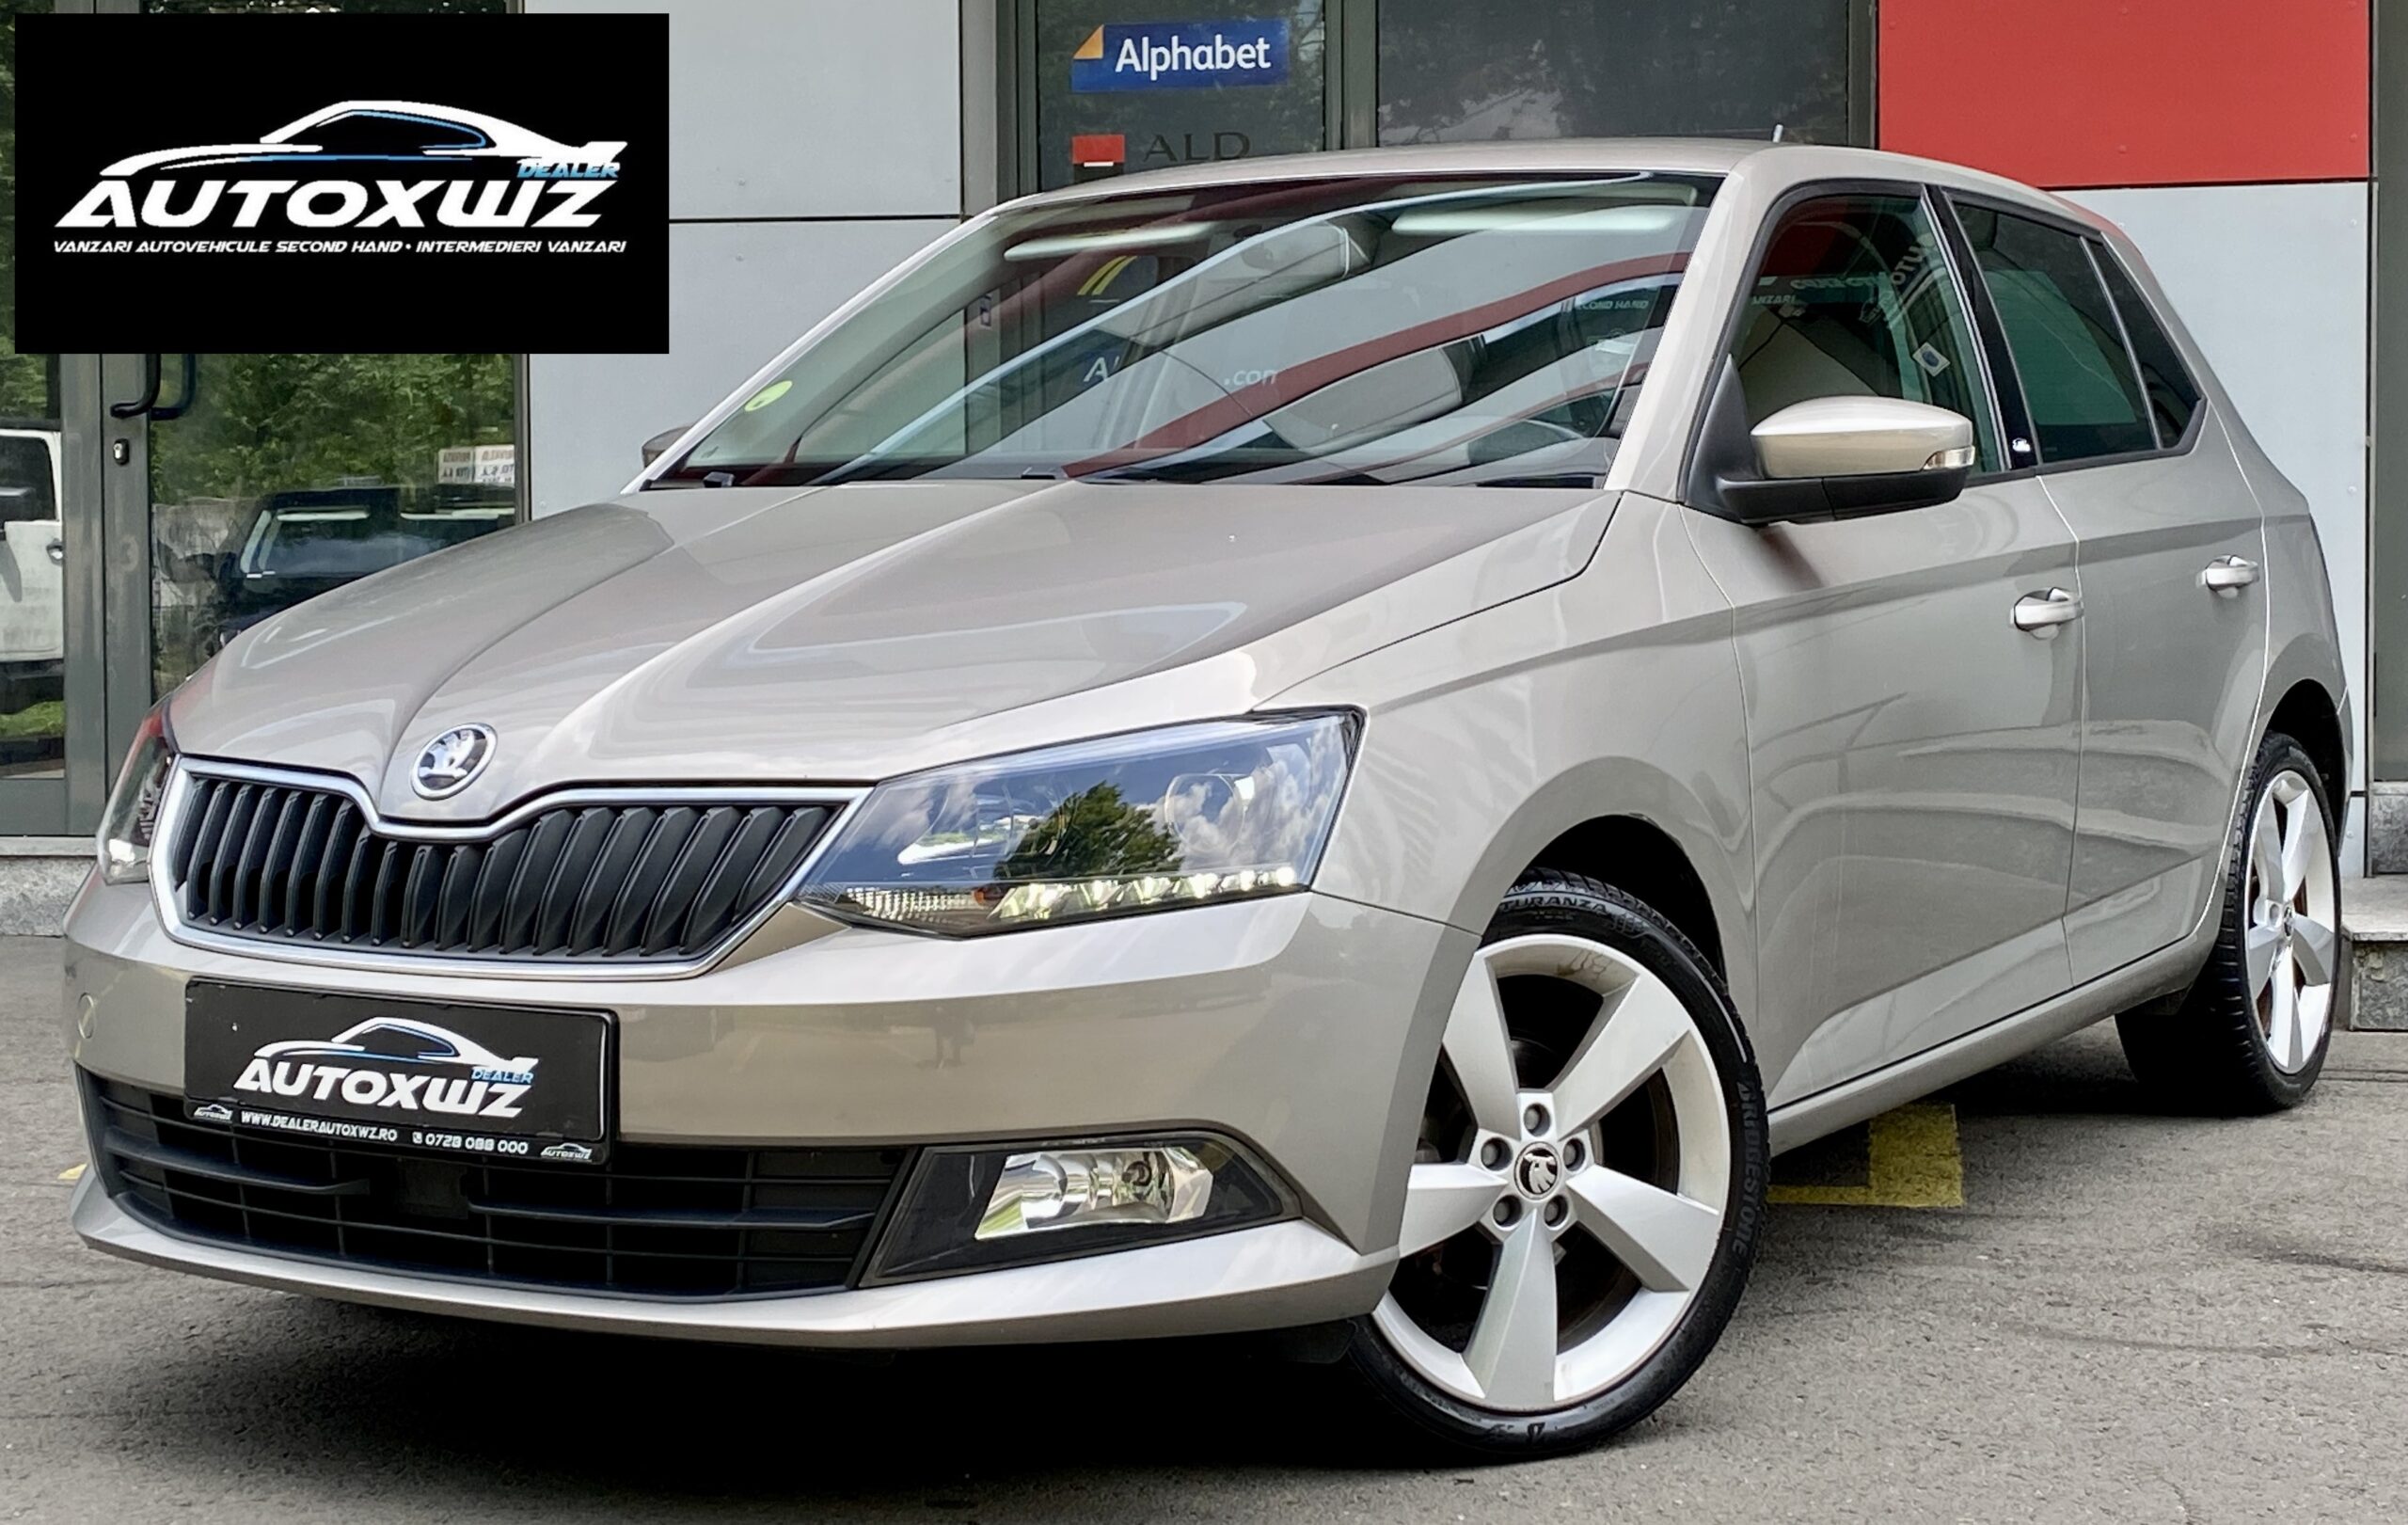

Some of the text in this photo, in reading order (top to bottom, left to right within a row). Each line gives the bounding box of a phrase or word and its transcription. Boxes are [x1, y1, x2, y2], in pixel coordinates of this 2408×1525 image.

[1115, 34, 1272, 81] Alphabet
[1143, 132, 1250, 162] ALD
[1502, 896, 1609, 915] TURANZA
[231, 1057, 533, 1119] AUTOXWZ
[471, 1066, 534, 1084] DEALER
[241, 1110, 398, 1142] WWW.DEALERAUTOXWZ.RO
[498, 1139, 529, 1155] 000
